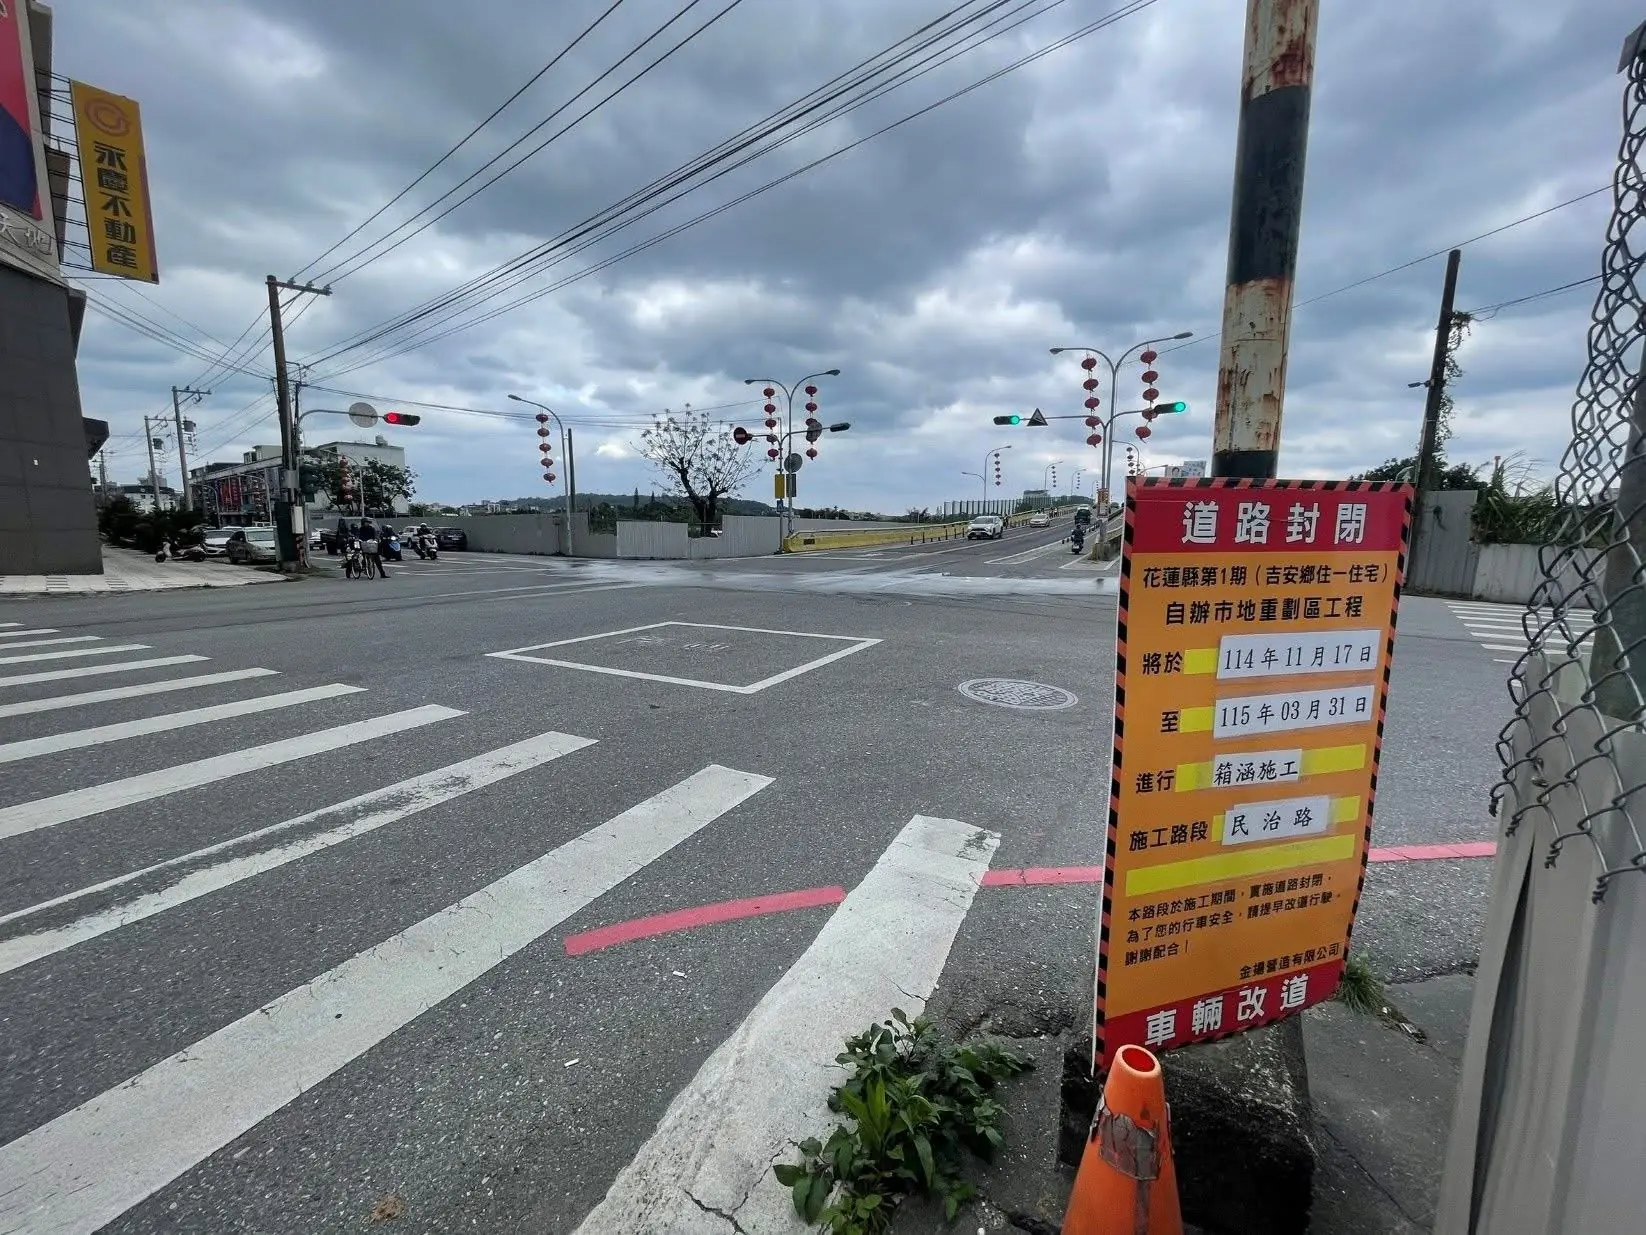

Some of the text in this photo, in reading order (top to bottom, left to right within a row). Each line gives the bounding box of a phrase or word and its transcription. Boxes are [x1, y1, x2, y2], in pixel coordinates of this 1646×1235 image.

[1181, 500, 1367, 545] 道路封閉
[1165, 595, 1363, 626] 自辦市地重劃區工程
[1142, 650, 1183, 675] 將於
[1160, 710, 1180, 733] 至
[1134, 759, 1300, 794] 進行 箱涵施工
[1128, 806, 1313, 852] 施工路段 民治路
[1144, 973, 1309, 1047] 車輛改道
